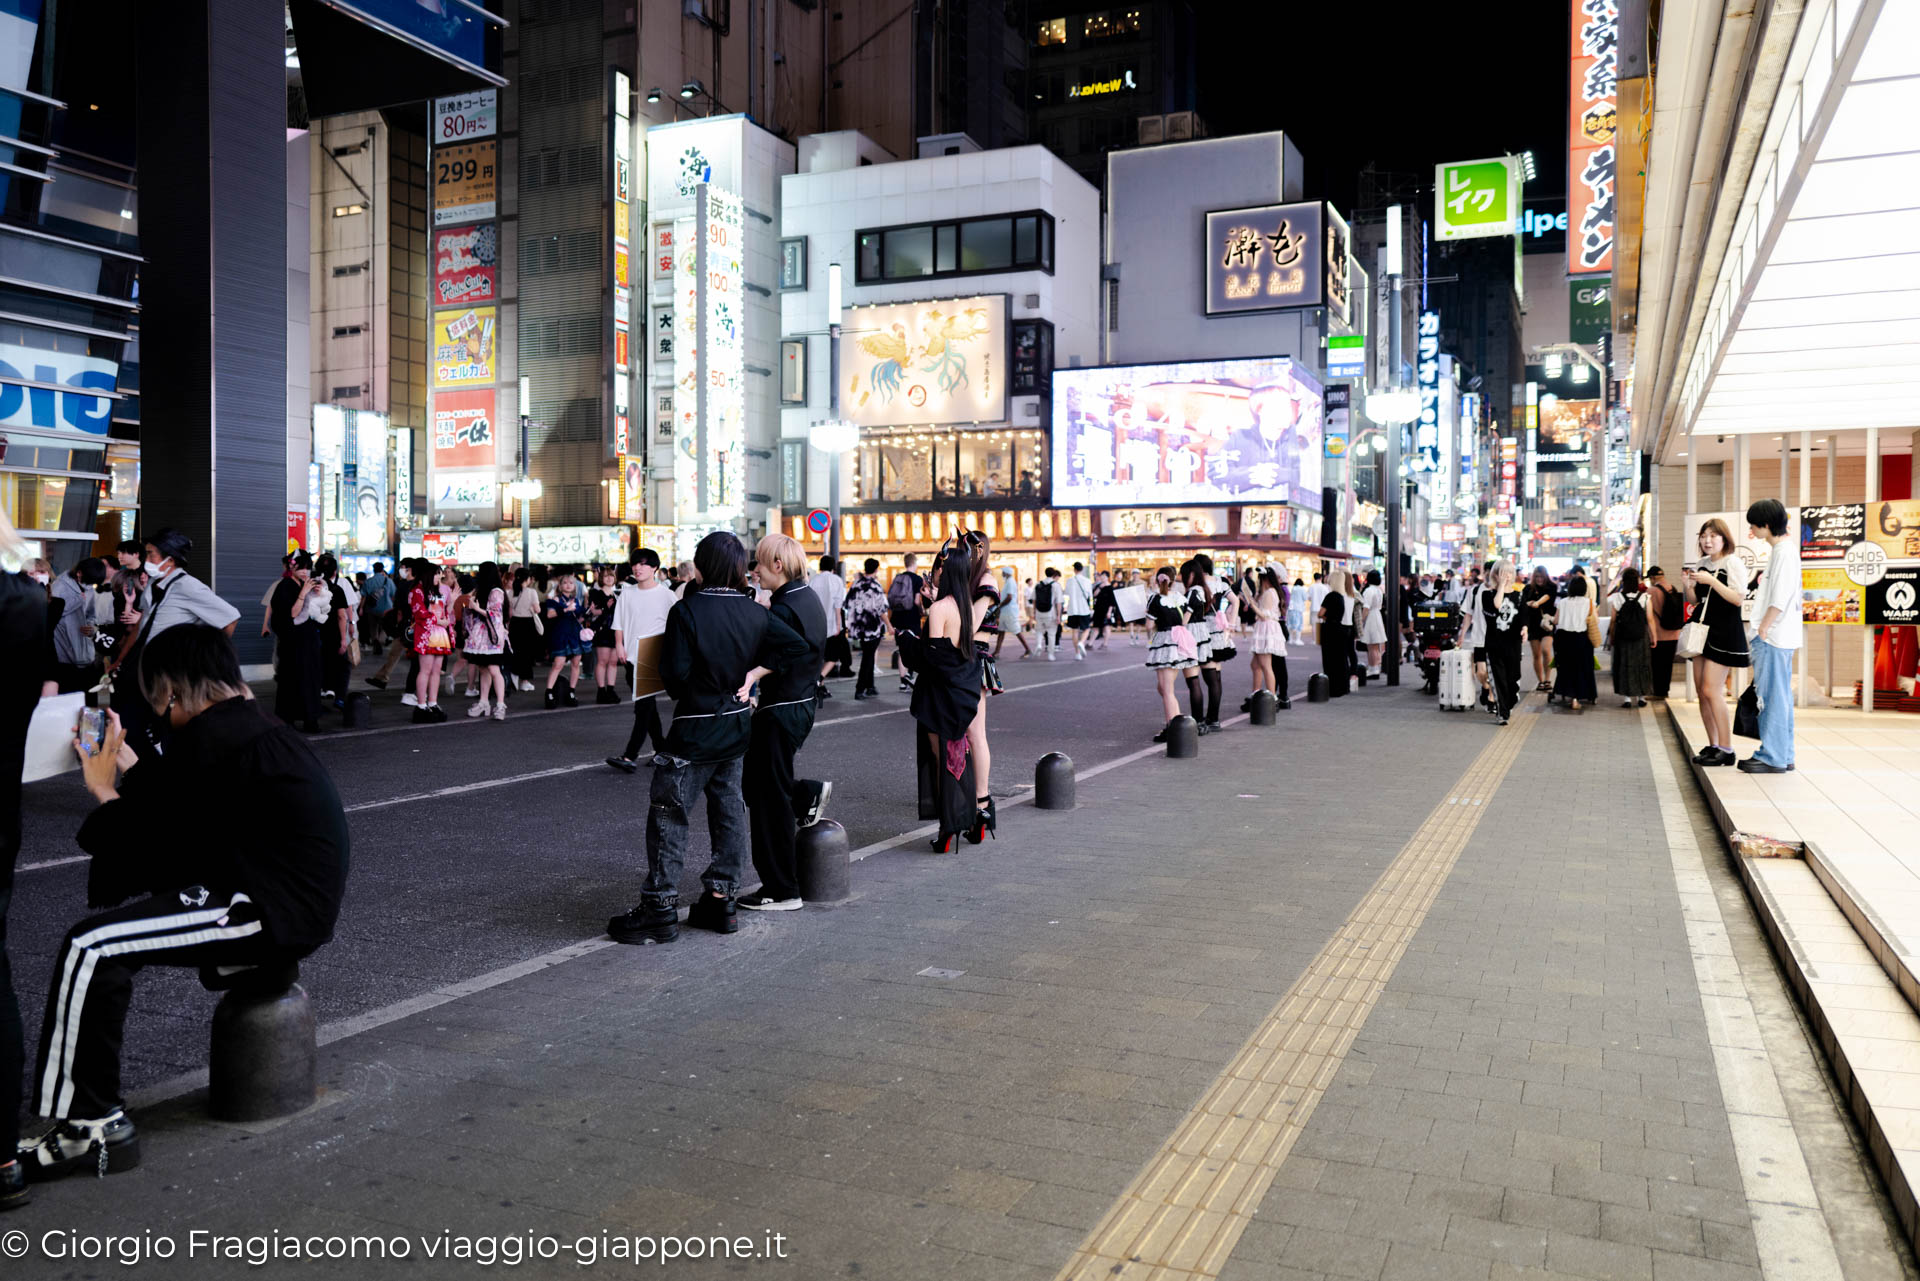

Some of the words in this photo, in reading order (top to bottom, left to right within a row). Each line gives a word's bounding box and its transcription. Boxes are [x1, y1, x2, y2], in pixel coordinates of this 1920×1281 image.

[439, 97, 494, 114] 豆挽きコーヒー
[438, 159, 477, 186] 299
[483, 165, 494, 178] 円
[660, 231, 672, 271] 激安
[708, 272, 728, 293] 100
[659, 314, 672, 353] 大衆
[439, 364, 490, 380] ウェルカム
[711, 370, 726, 388] 50
[659, 396, 672, 435] 酒場
[458, 420, 490, 443] 一休
[1801, 505, 1863, 518] インターネット
